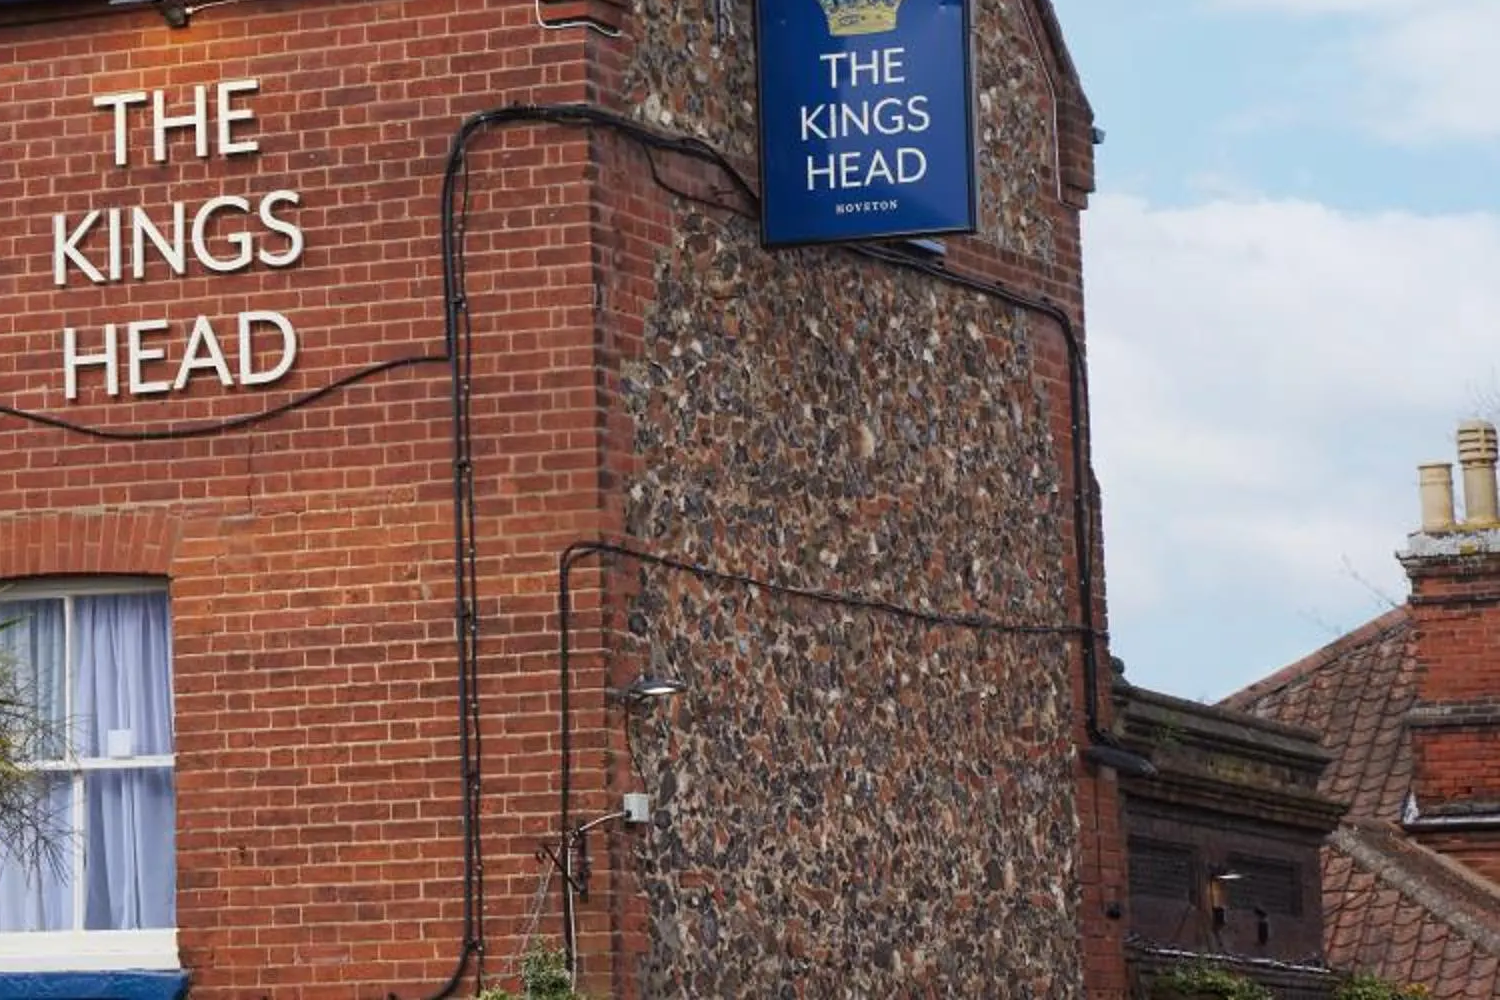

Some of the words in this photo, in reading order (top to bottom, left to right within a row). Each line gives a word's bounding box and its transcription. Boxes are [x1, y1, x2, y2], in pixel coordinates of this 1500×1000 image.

[820, 48, 906, 88] THE
[93, 79, 259, 165] THE
[800, 96, 931, 141] KINGS
[807, 147, 928, 191] HEAD
[54, 189, 304, 286] KINGS
[64, 310, 297, 399] HEAD
